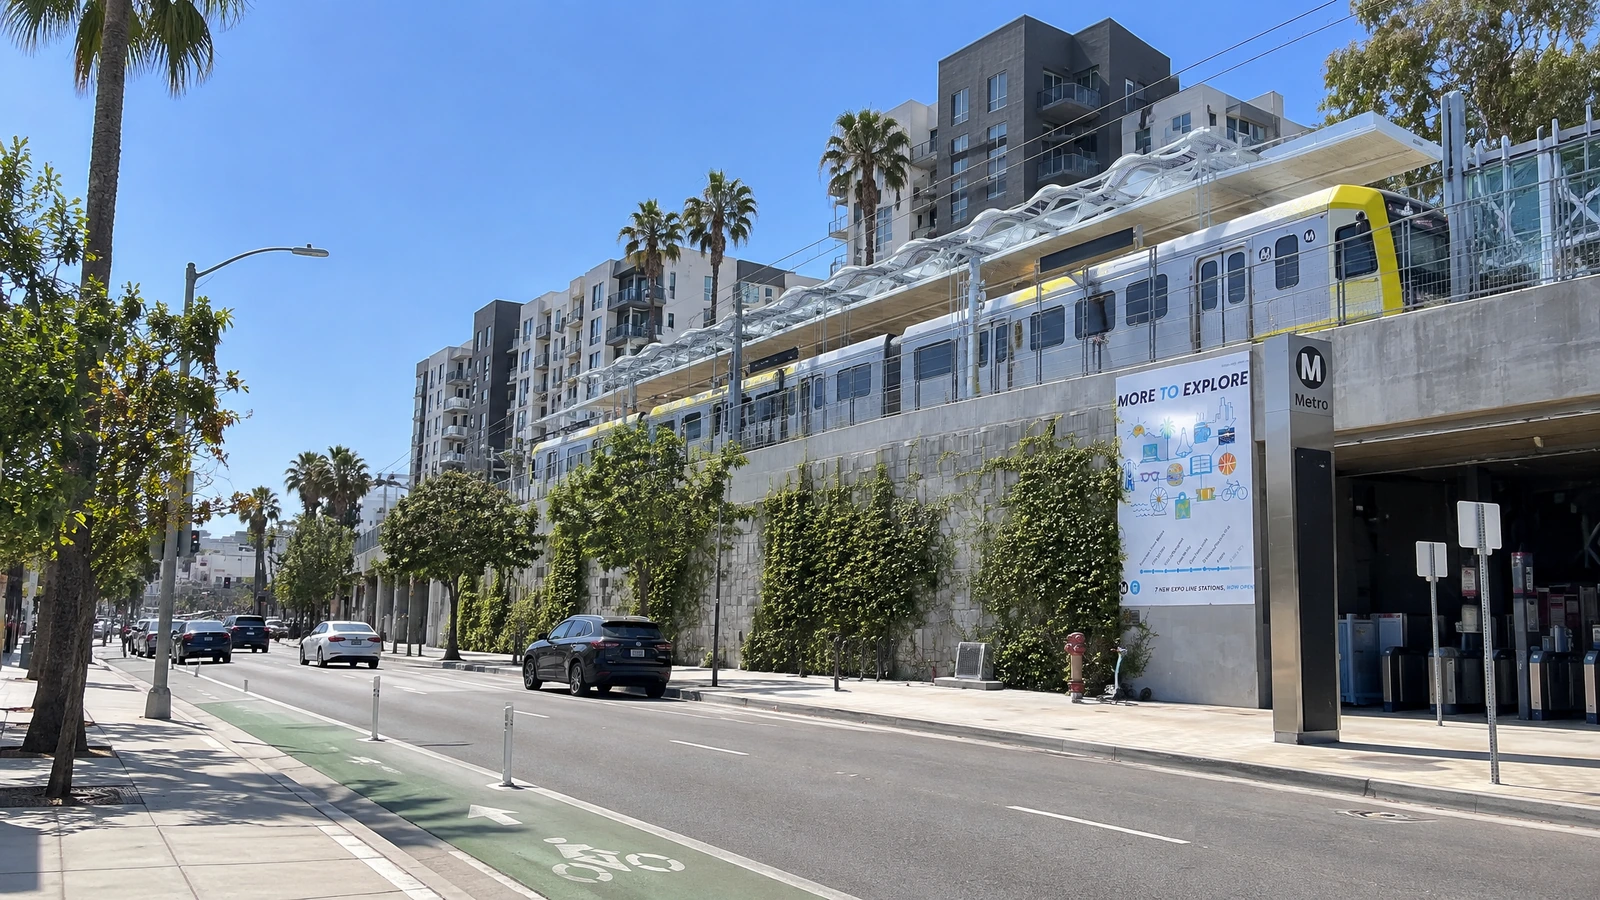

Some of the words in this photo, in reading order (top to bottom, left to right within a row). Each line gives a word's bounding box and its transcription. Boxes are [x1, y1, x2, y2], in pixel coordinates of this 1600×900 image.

[1301, 352, 1322, 383] M
[1117, 388, 1156, 407] MORE
[1160, 384, 1179, 400] TO
[1183, 370, 1249, 396] EXPLORE
[1295, 392, 1329, 410] Metro
[1198, 584, 1226, 592] STATIONS,
